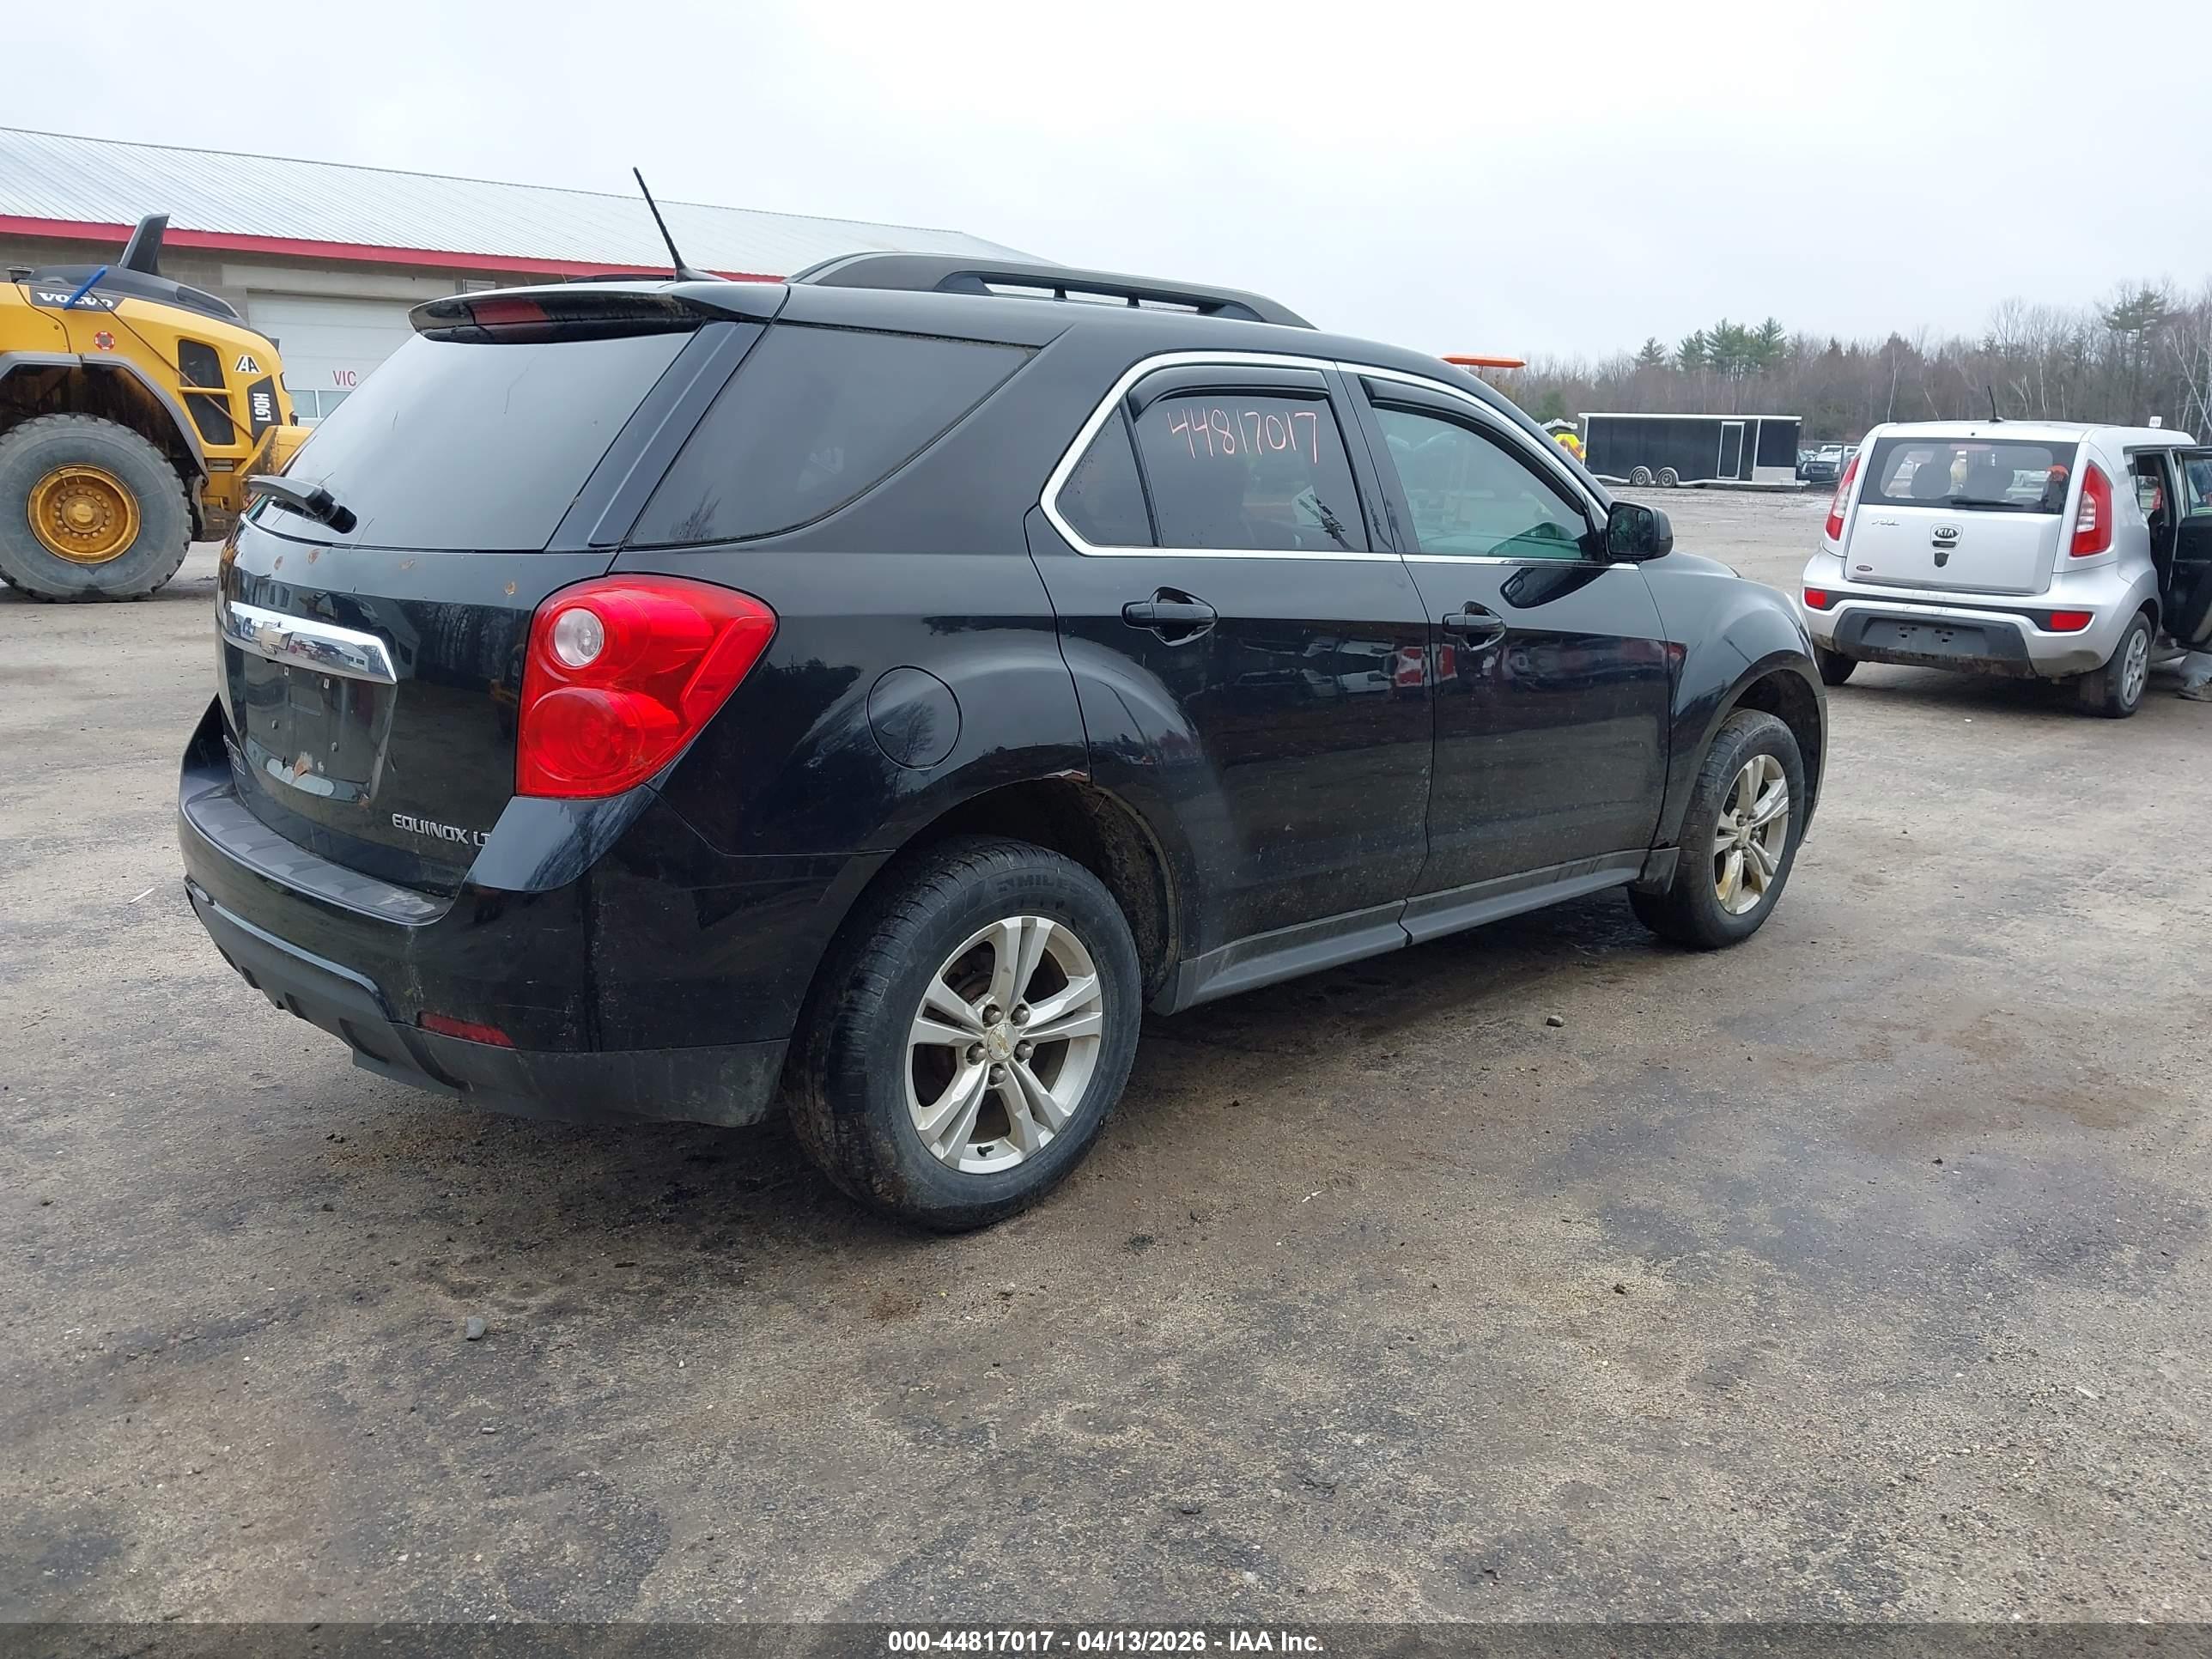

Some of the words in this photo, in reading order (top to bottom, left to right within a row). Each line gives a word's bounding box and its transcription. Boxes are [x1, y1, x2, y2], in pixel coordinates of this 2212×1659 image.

[332, 370, 357, 386] VIC
[252, 392, 272, 422] L90H
[1167, 407, 1318, 465] 44817017
[1936, 528, 1955, 538] KIA
[392, 813, 469, 845] EQUINOX
